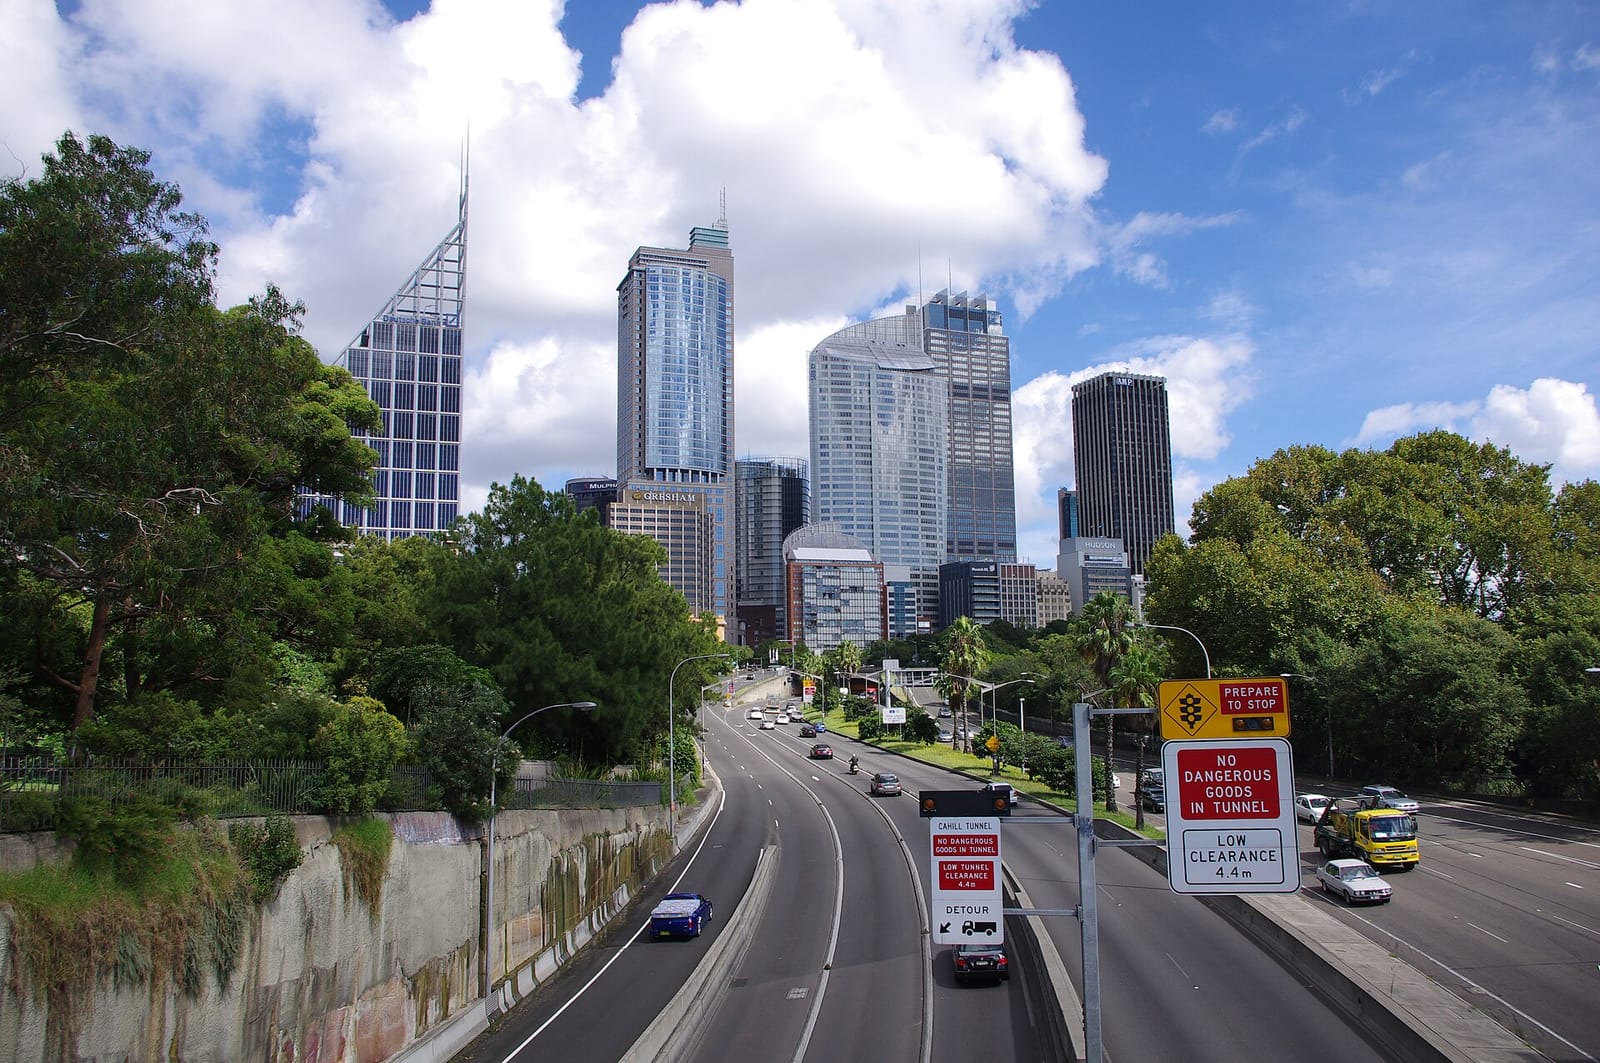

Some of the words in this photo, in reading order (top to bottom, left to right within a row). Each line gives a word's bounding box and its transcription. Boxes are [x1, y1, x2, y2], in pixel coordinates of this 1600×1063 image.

[643, 492, 696, 502] GRESHAM
[1085, 541, 1116, 549] HUDSON
[1224, 686, 1279, 697] PREPARE
[1228, 700, 1241, 710] TO
[1247, 699, 1276, 709] STOP
[1217, 754, 1236, 766] NO
[1184, 769, 1272, 783] DANGEROUS
[1205, 786, 1253, 798] GOODS
[1191, 802, 1204, 814] IN
[1213, 801, 1270, 814] TUNNEL
[938, 822, 962, 830] CAHILL
[966, 822, 993, 830] TUNNEL
[1217, 834, 1246, 847] LOW
[1190, 850, 1277, 863] CLEARANCE
[1215, 867, 1252, 879] 4.4m
[946, 906, 989, 914] DETOUR
